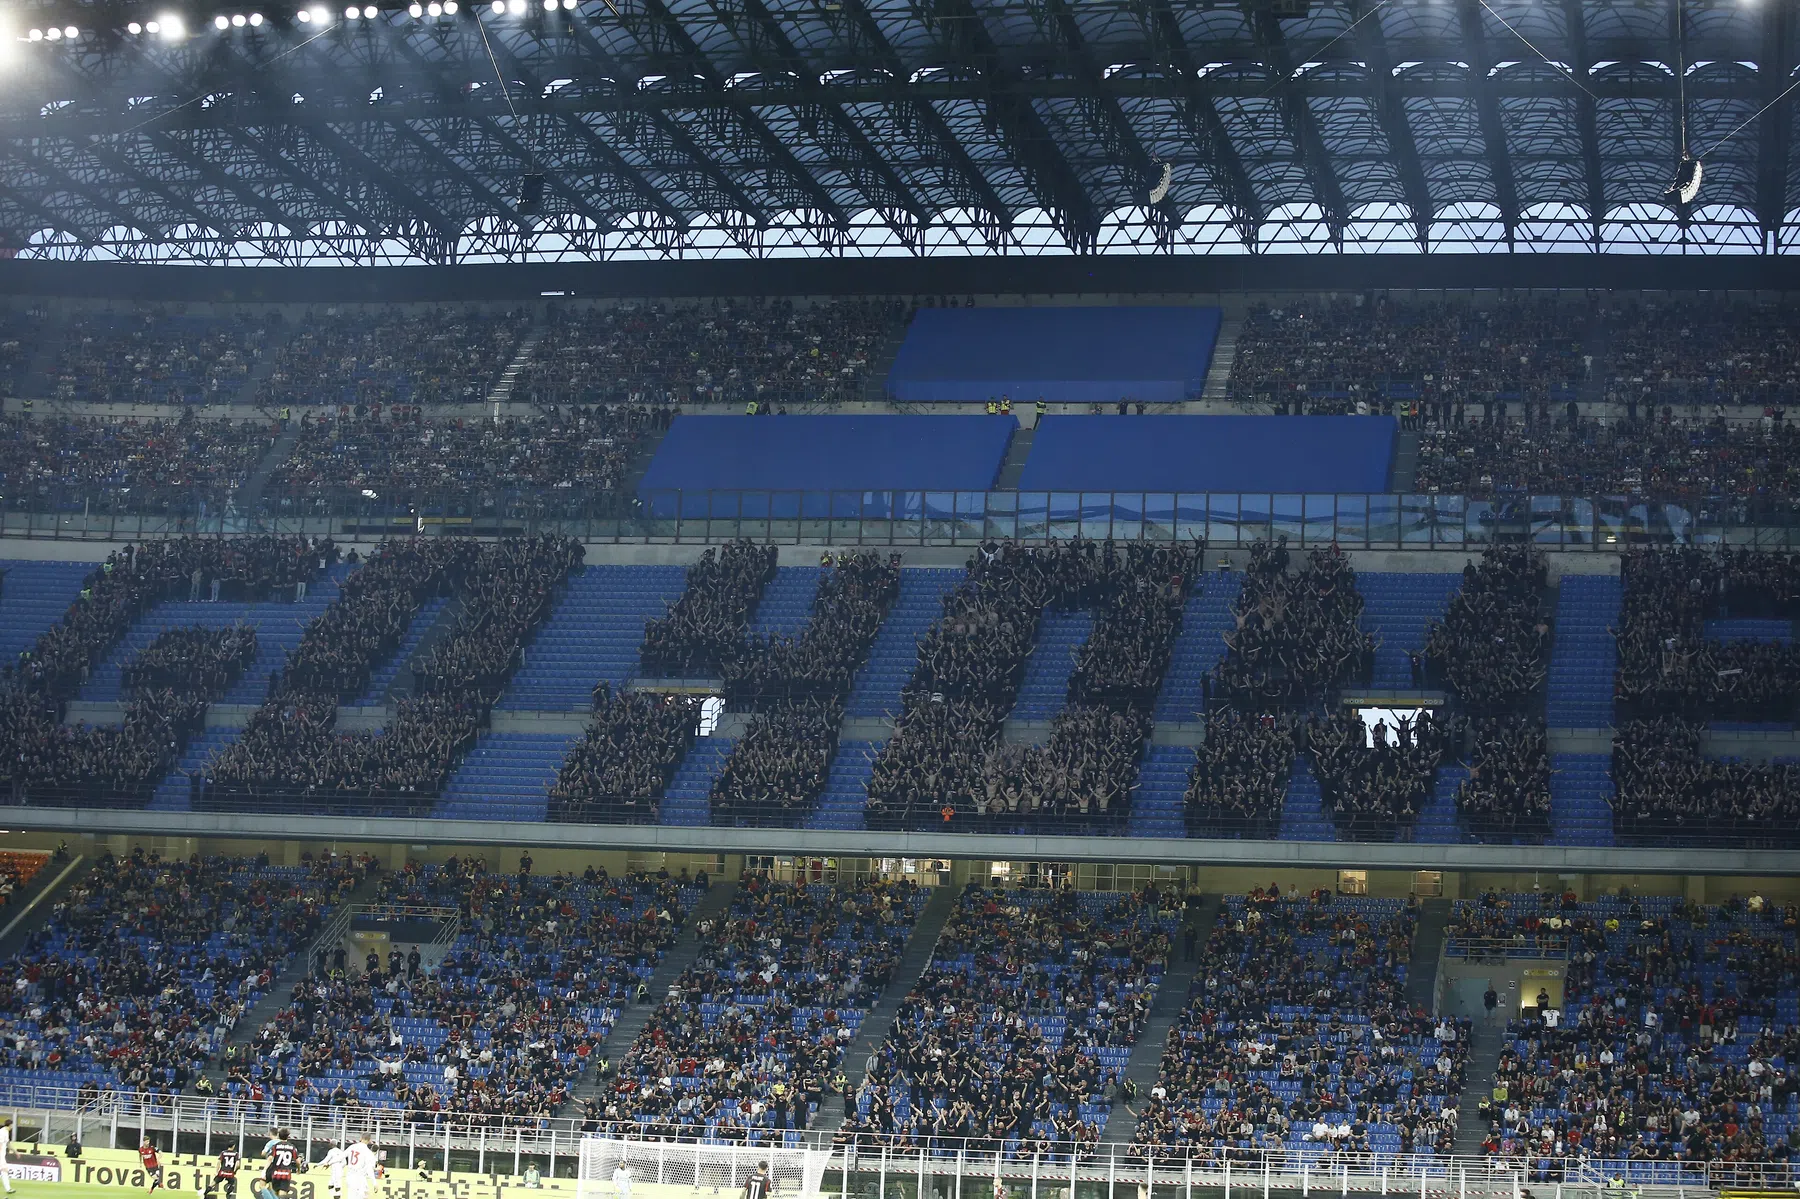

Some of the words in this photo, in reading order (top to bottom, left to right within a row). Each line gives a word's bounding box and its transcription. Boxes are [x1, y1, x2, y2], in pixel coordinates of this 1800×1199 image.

[224, 1156, 235, 1168] 14
[275, 1150, 293, 1166] 79
[350, 1149, 361, 1165] 13
[70, 1159, 145, 1187] Trova
[158, 1165, 181, 1189] la
[750, 1181, 761, 1199] 11
